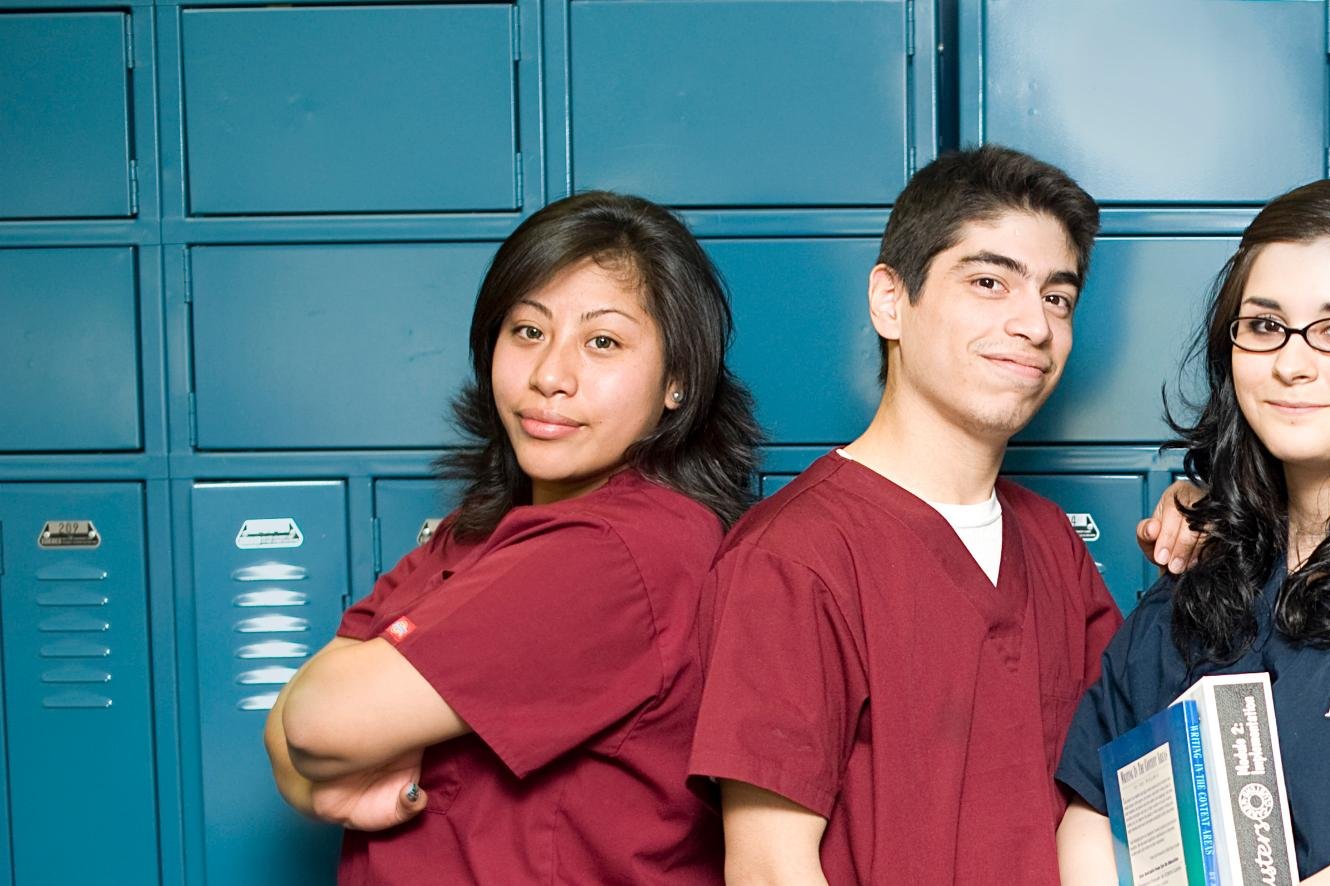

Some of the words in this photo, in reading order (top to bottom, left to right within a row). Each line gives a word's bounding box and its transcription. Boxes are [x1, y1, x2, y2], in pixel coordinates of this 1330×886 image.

[1230, 722, 1245, 736] 2:
[1189, 725, 1203, 759] WRITING
[1194, 763, 1204, 772] IN
[1195, 774, 1207, 790] THE
[1198, 792, 1211, 827] CONTENT
[1202, 830, 1214, 856] AREAS
